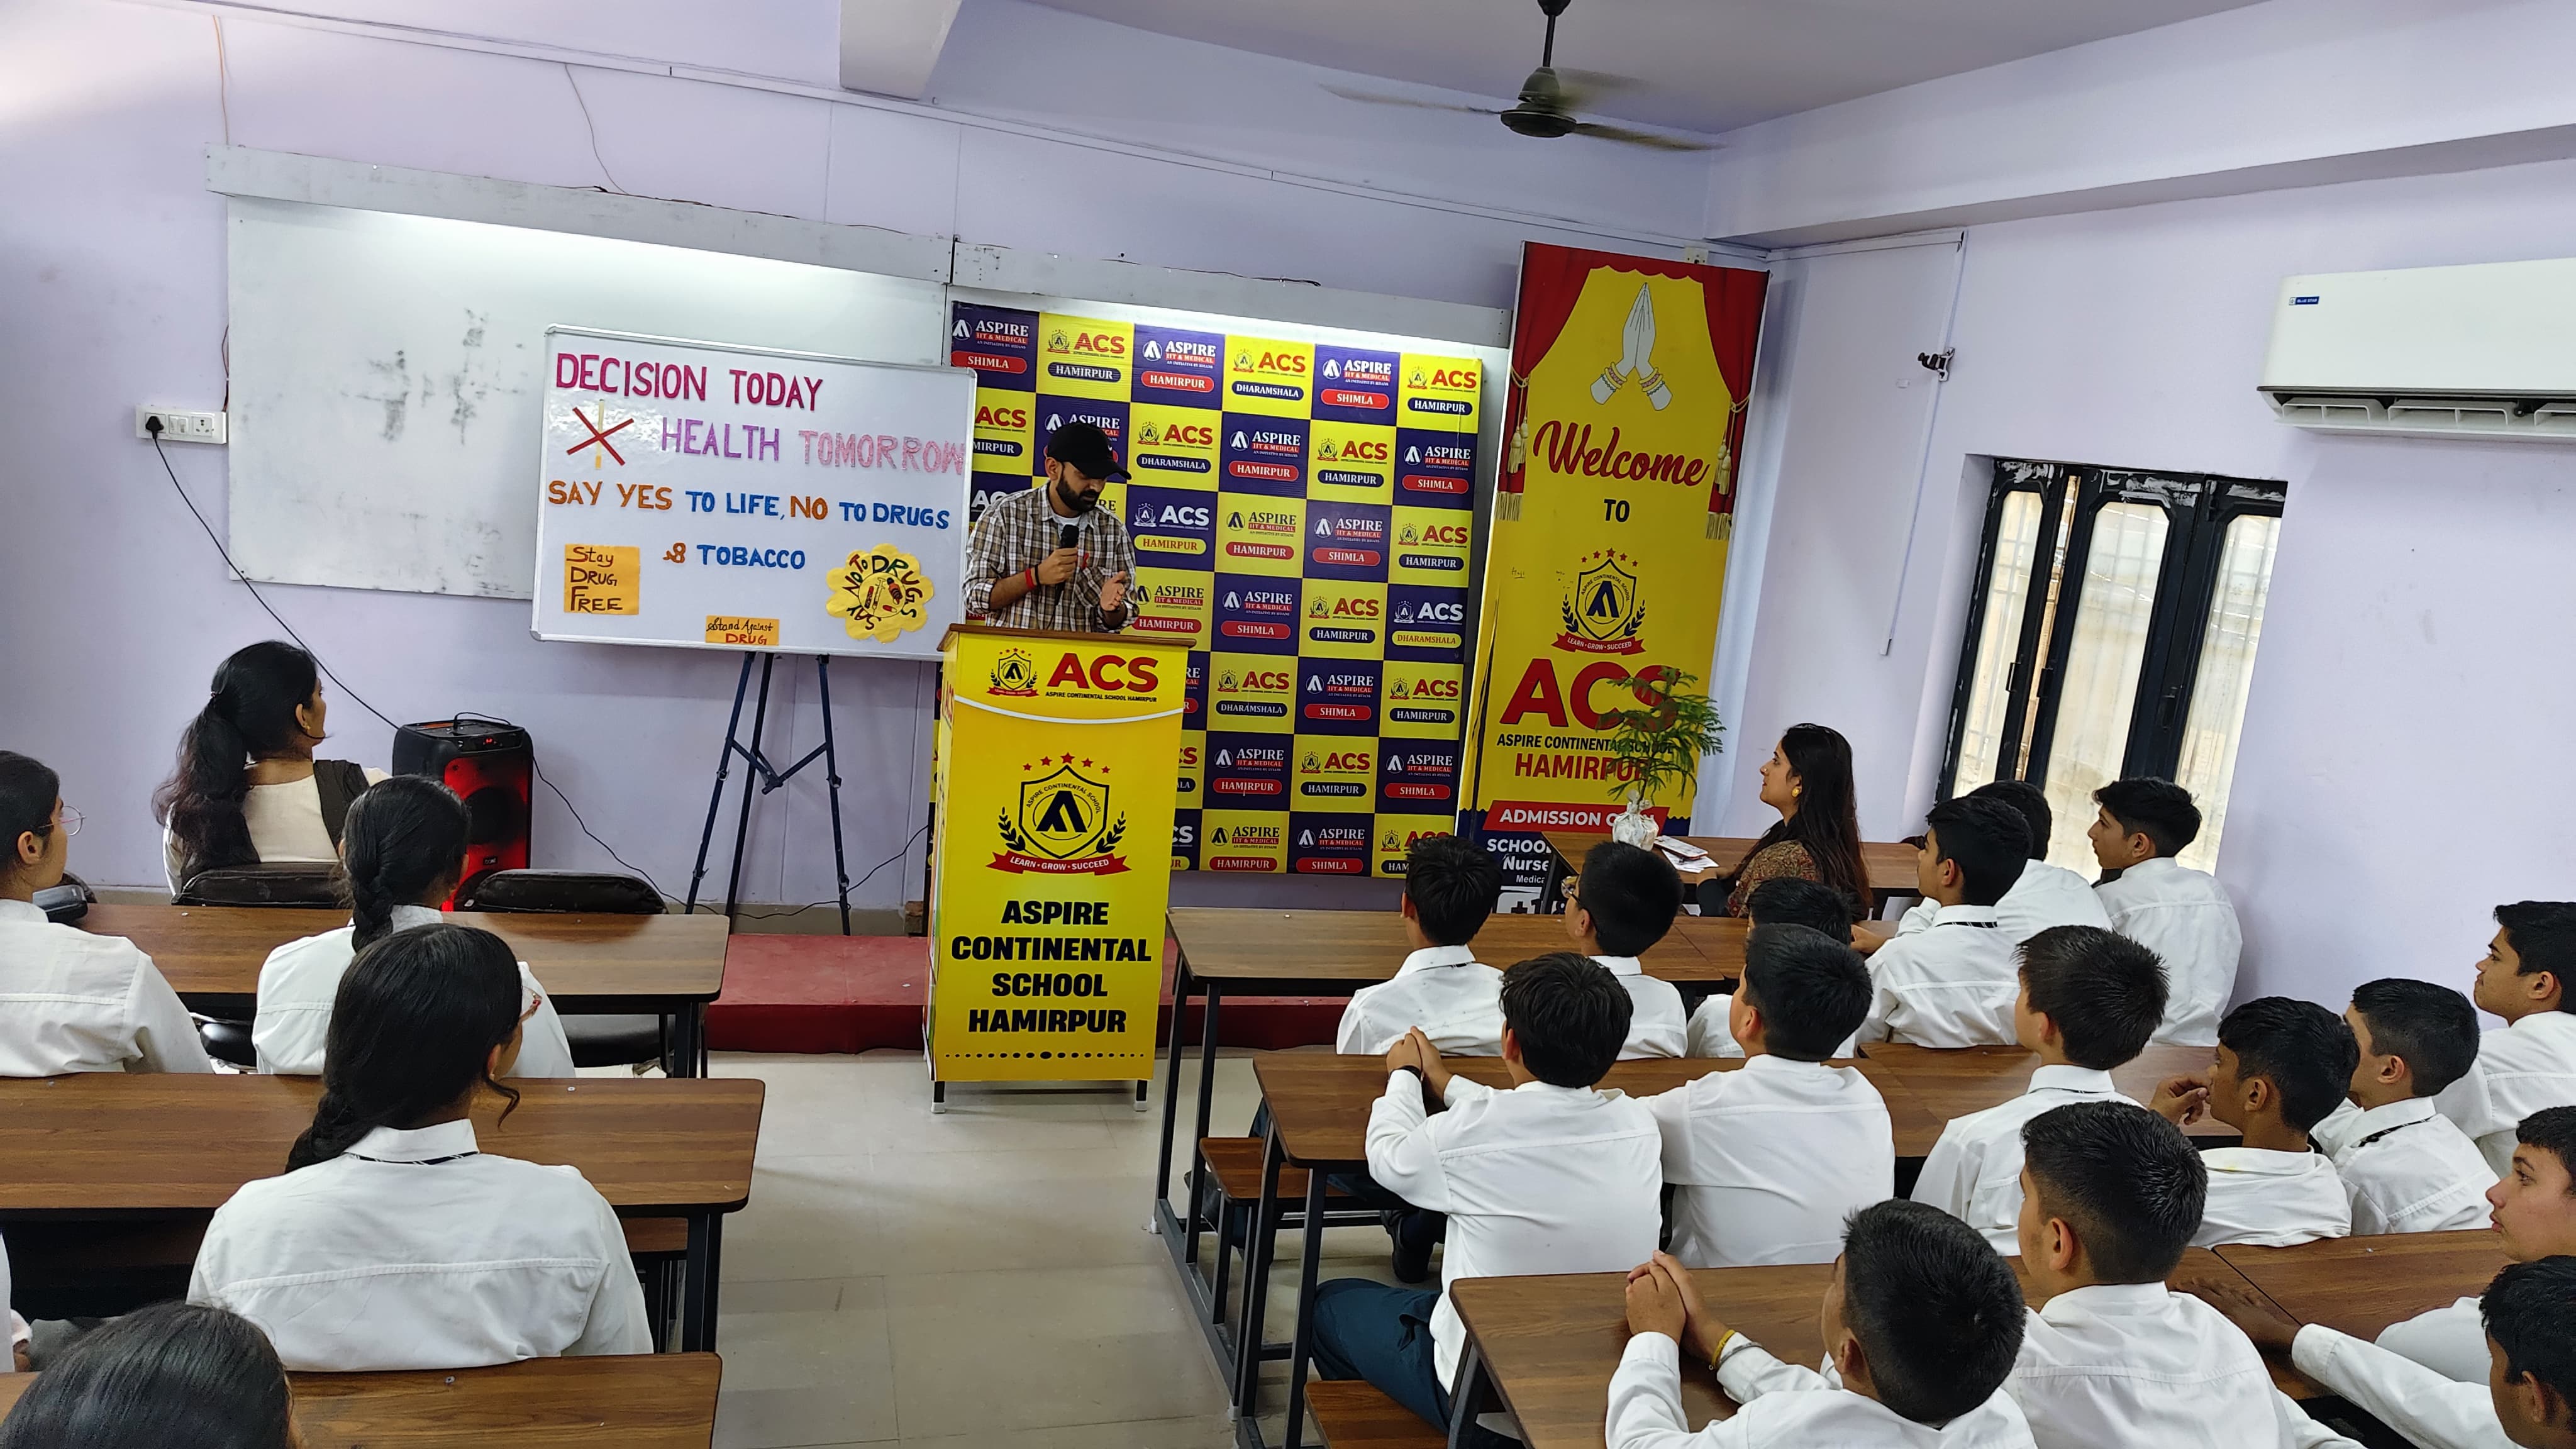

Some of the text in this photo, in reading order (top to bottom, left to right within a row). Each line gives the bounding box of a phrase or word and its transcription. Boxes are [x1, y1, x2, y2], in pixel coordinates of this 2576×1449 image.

[975, 319, 1029, 337] ASPIRE
[995, 335, 1026, 343] MEDICAL
[1074, 331, 1125, 355] ACS
[1165, 340, 1216, 357] ASPIRE
[968, 355, 1009, 368] SHIMLA
[1184, 355, 1213, 363] MEDICAL
[1258, 351, 1306, 373] ACS
[1055, 364, 1113, 379] HAMIRPUR
[1343, 358, 1392, 375] ASPIRE
[556, 353, 823, 411] DECISION TODAY
[1150, 374, 1205, 388] HAMIRPUR
[1431, 368, 1477, 389] ACS
[1236, 384, 1298, 397] DHARAMSHALA
[1336, 392, 1373, 404] SHIMLA
[1414, 399, 1466, 413] HAMIRPUR
[975, 406, 1026, 428] ACS
[1163, 423, 1213, 445] ACS
[1252, 431, 1300, 446] ASPIRE
[661, 417, 966, 475] HEALTH TOMORROW
[973, 441, 1014, 453] MIRPUR
[1270, 444, 1297, 452] MEDICAL
[1341, 440, 1388, 460] ACS
[1425, 446, 1471, 459] ASPIRE
[1532, 419, 1711, 487] Welcome
[1141, 456, 1206, 469] DHARAMSHALA
[1237, 464, 1290, 477] HAMIRPUR
[1324, 472, 1376, 484] HAMIRPUR
[1418, 479, 1453, 489] SHIMLA
[548, 480, 950, 530] SAY YES TO LIFE, NO TO DRUGS
[1604, 499, 1630, 523] TO
[1160, 504, 1209, 526] ACS
[1248, 511, 1296, 525] ASPIRE
[1336, 518, 1382, 531] ASPIRE
[1422, 525, 1468, 543] ACS
[1142, 538, 1197, 550] HAMIRPUR
[1233, 545, 1286, 557] HAMIRPUR
[567, 547, 614, 567] Stay
[697, 544, 806, 570] TOBACCO
[849, 554, 868, 573] TO
[1328, 552, 1364, 562] SHIMLA
[1406, 557, 1456, 567] HAMIRPUR
[570, 567, 618, 586] DRUG
[842, 572, 863, 597] NO
[872, 555, 923, 618] DRUGS
[1154, 585, 1204, 598] ASPIRE
[570, 586, 623, 613] FREE
[1245, 591, 1292, 604] ASPIRE
[1333, 597, 1379, 616] ACS
[1418, 602, 1463, 621] ACS
[1138, 619, 1193, 630] HAMIRPUR
[1237, 625, 1274, 635] SHIMLA
[725, 633, 767, 645] DRUG
[1316, 630, 1368, 640] HAMIRPUR
[1397, 634, 1455, 644] DHARAMSHALA
[1567, 636, 1584, 647] LEARN
[1606, 641, 1632, 650] SUCCEED
[1046, 652, 1159, 693] ACS
[1241, 670, 1289, 690] ACS
[1327, 674, 1374, 686] ASPIRE
[1413, 679, 1458, 697] ACS
[1220, 703, 1282, 713] DHARAMSHALA
[1319, 707, 1356, 716] SHIMLA
[1397, 710, 1447, 720] HAMIRPUR
[1497, 734, 1542, 748] ASPIRE
[1236, 748, 1284, 760] ASPIRE
[1324, 752, 1370, 770] ACS
[1407, 754, 1453, 765] ASPIRE
[1221, 782, 1274, 791] HAMIRPUR
[1307, 784, 1359, 793] HAMIRPUR
[1400, 787, 1435, 796] SHIMLA
[1026, 783, 1102, 814] ASPIRE CONTINENTAL SCHOOL
[1499, 809, 1601, 826] ADMISSION
[1232, 826, 1280, 837] ASPIRE
[1319, 828, 1365, 839] ASPIRE
[1009, 856, 1109, 870] LEARN GROW SUCCEED
[1217, 859, 1269, 868] HAMIRPUR
[1311, 861, 1347, 869] SHIMLA
[1001, 900, 1110, 925] ASPIRE
[951, 936, 1152, 962] CONTINENTAL
[992, 973, 1108, 997] SCHOOL
[968, 1009, 1126, 1033] HAMIRPUR
